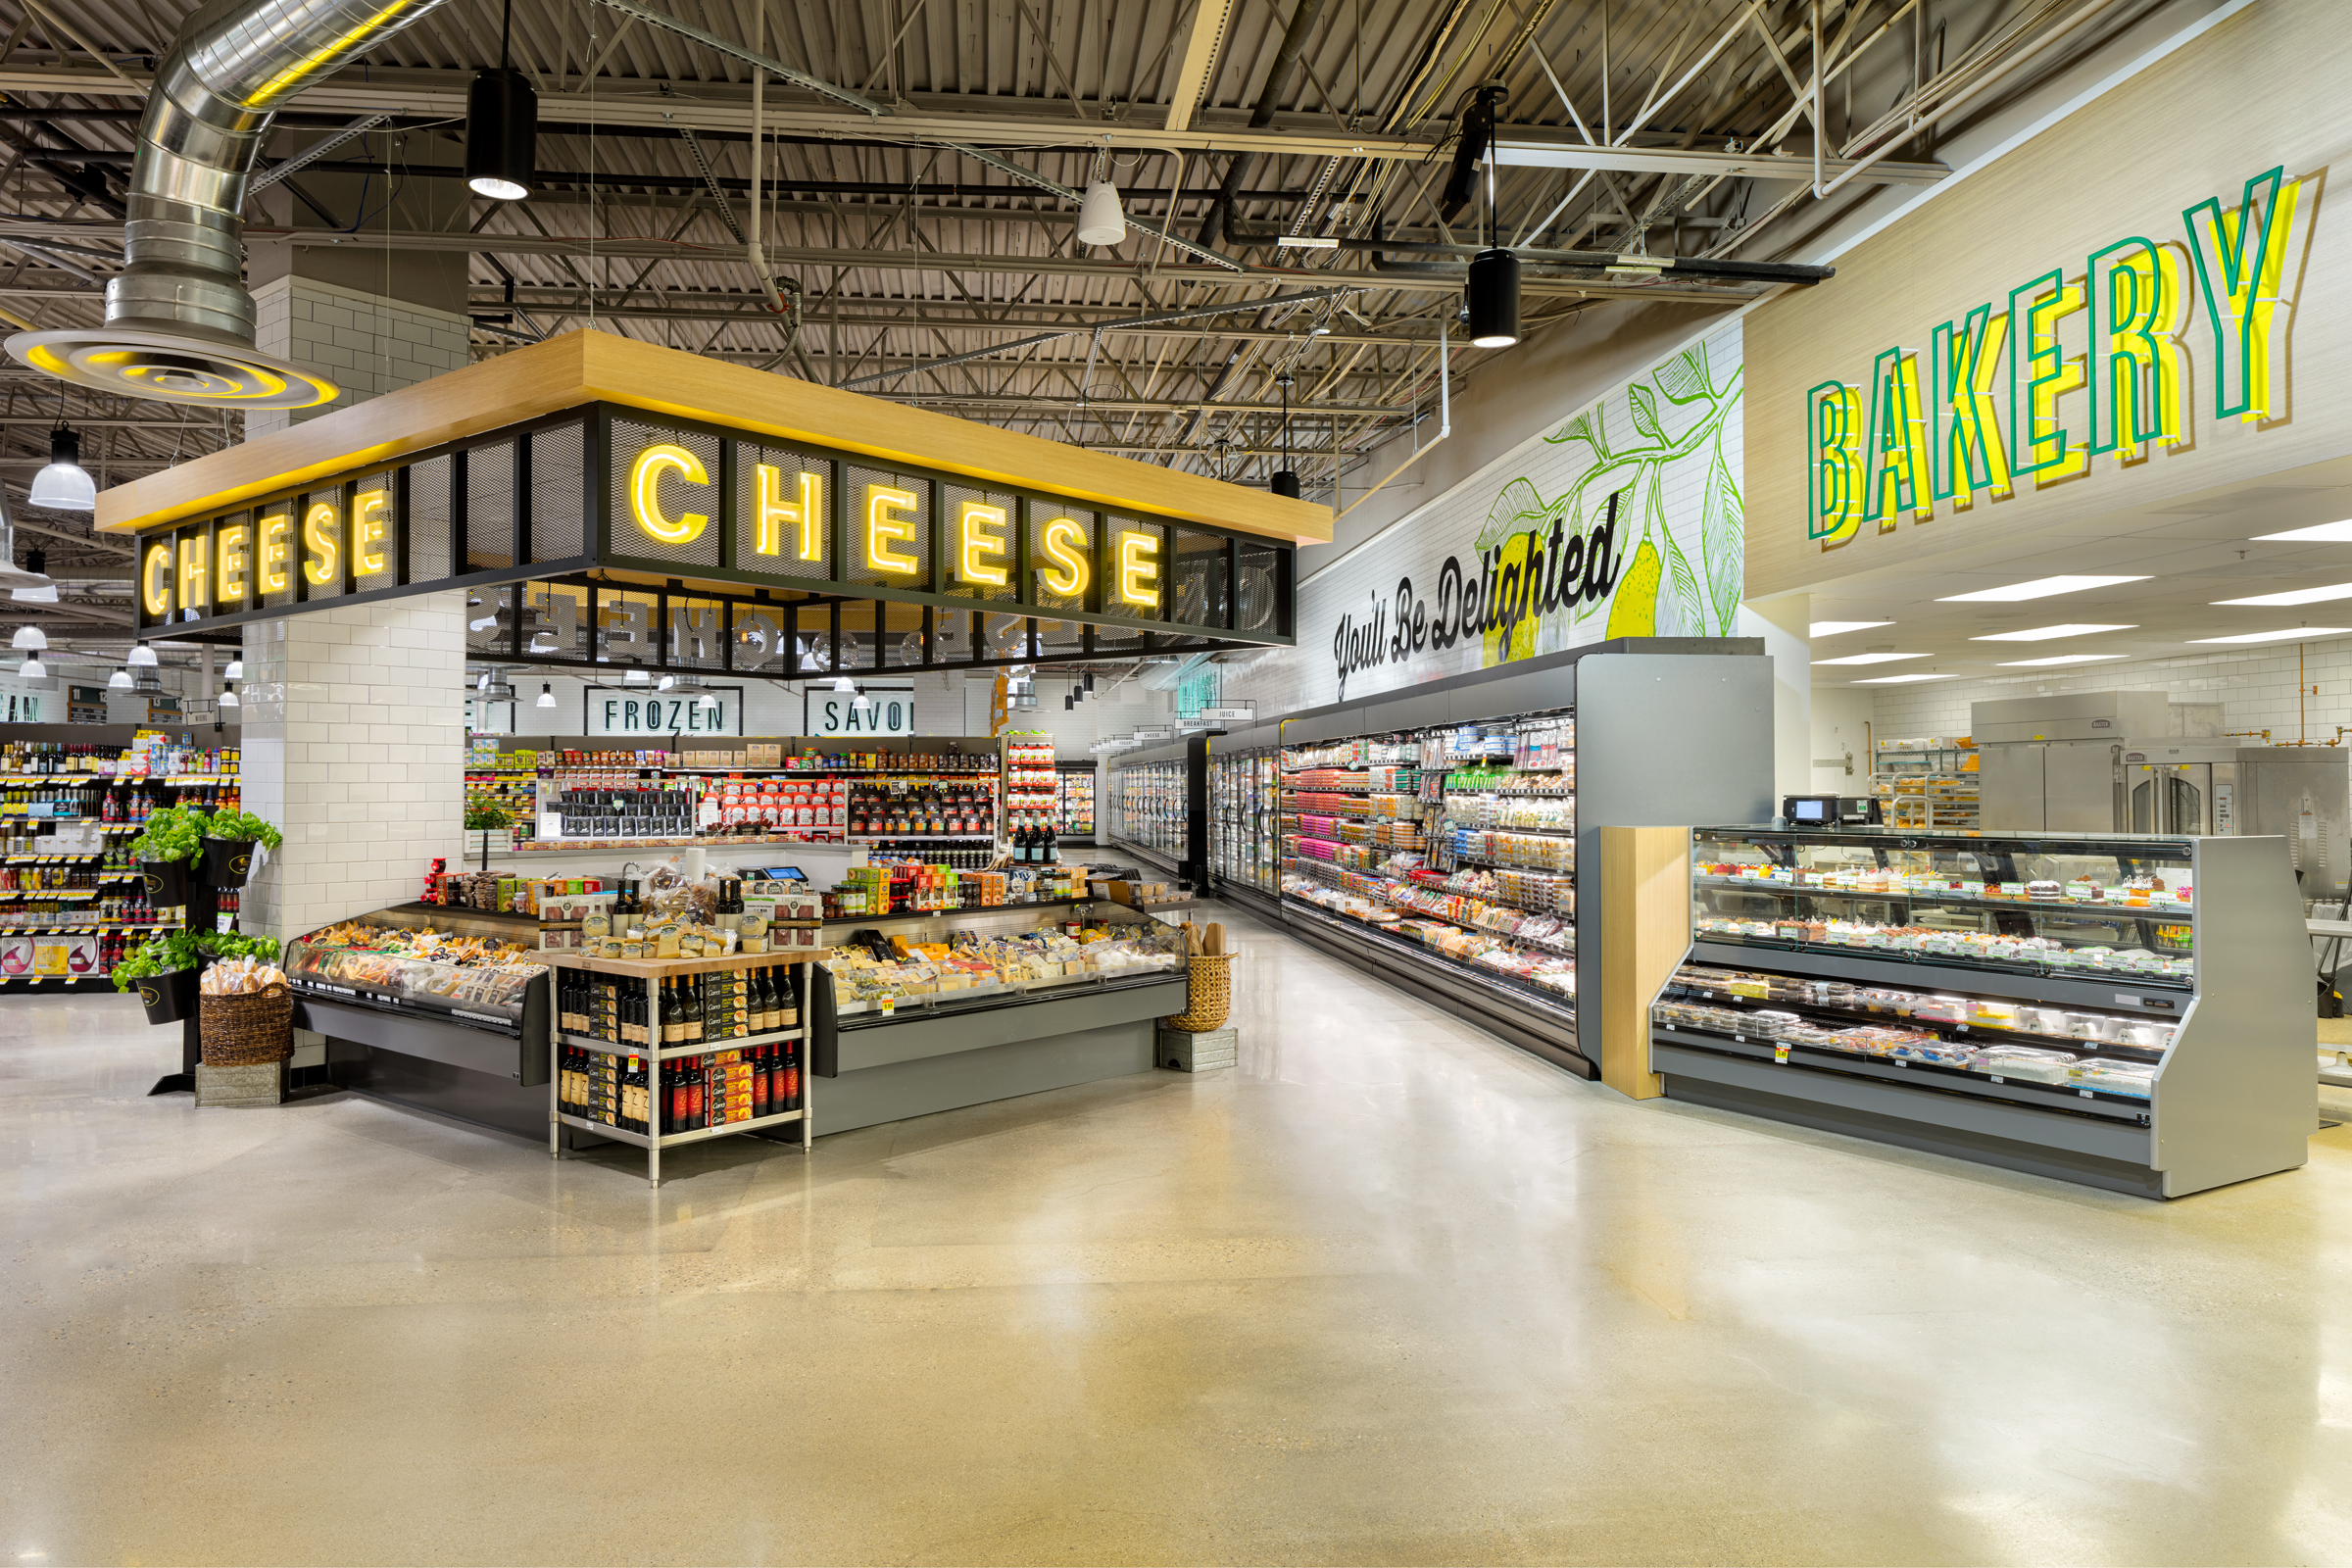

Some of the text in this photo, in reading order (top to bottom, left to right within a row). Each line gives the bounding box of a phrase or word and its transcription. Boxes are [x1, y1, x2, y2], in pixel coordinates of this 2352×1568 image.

[1807, 165, 2301, 543] BAKERY
[143, 488, 392, 615] CHEESE
[629, 443, 1160, 607] CHEESE
[1334, 589, 1388, 702] You'll
[1391, 576, 1428, 663] Be
[1432, 492, 1621, 663] Delighted
[73, 689, 107, 703] 11 12
[605, 700, 724, 731] FROZEN
[824, 701, 913, 731] SAVO
